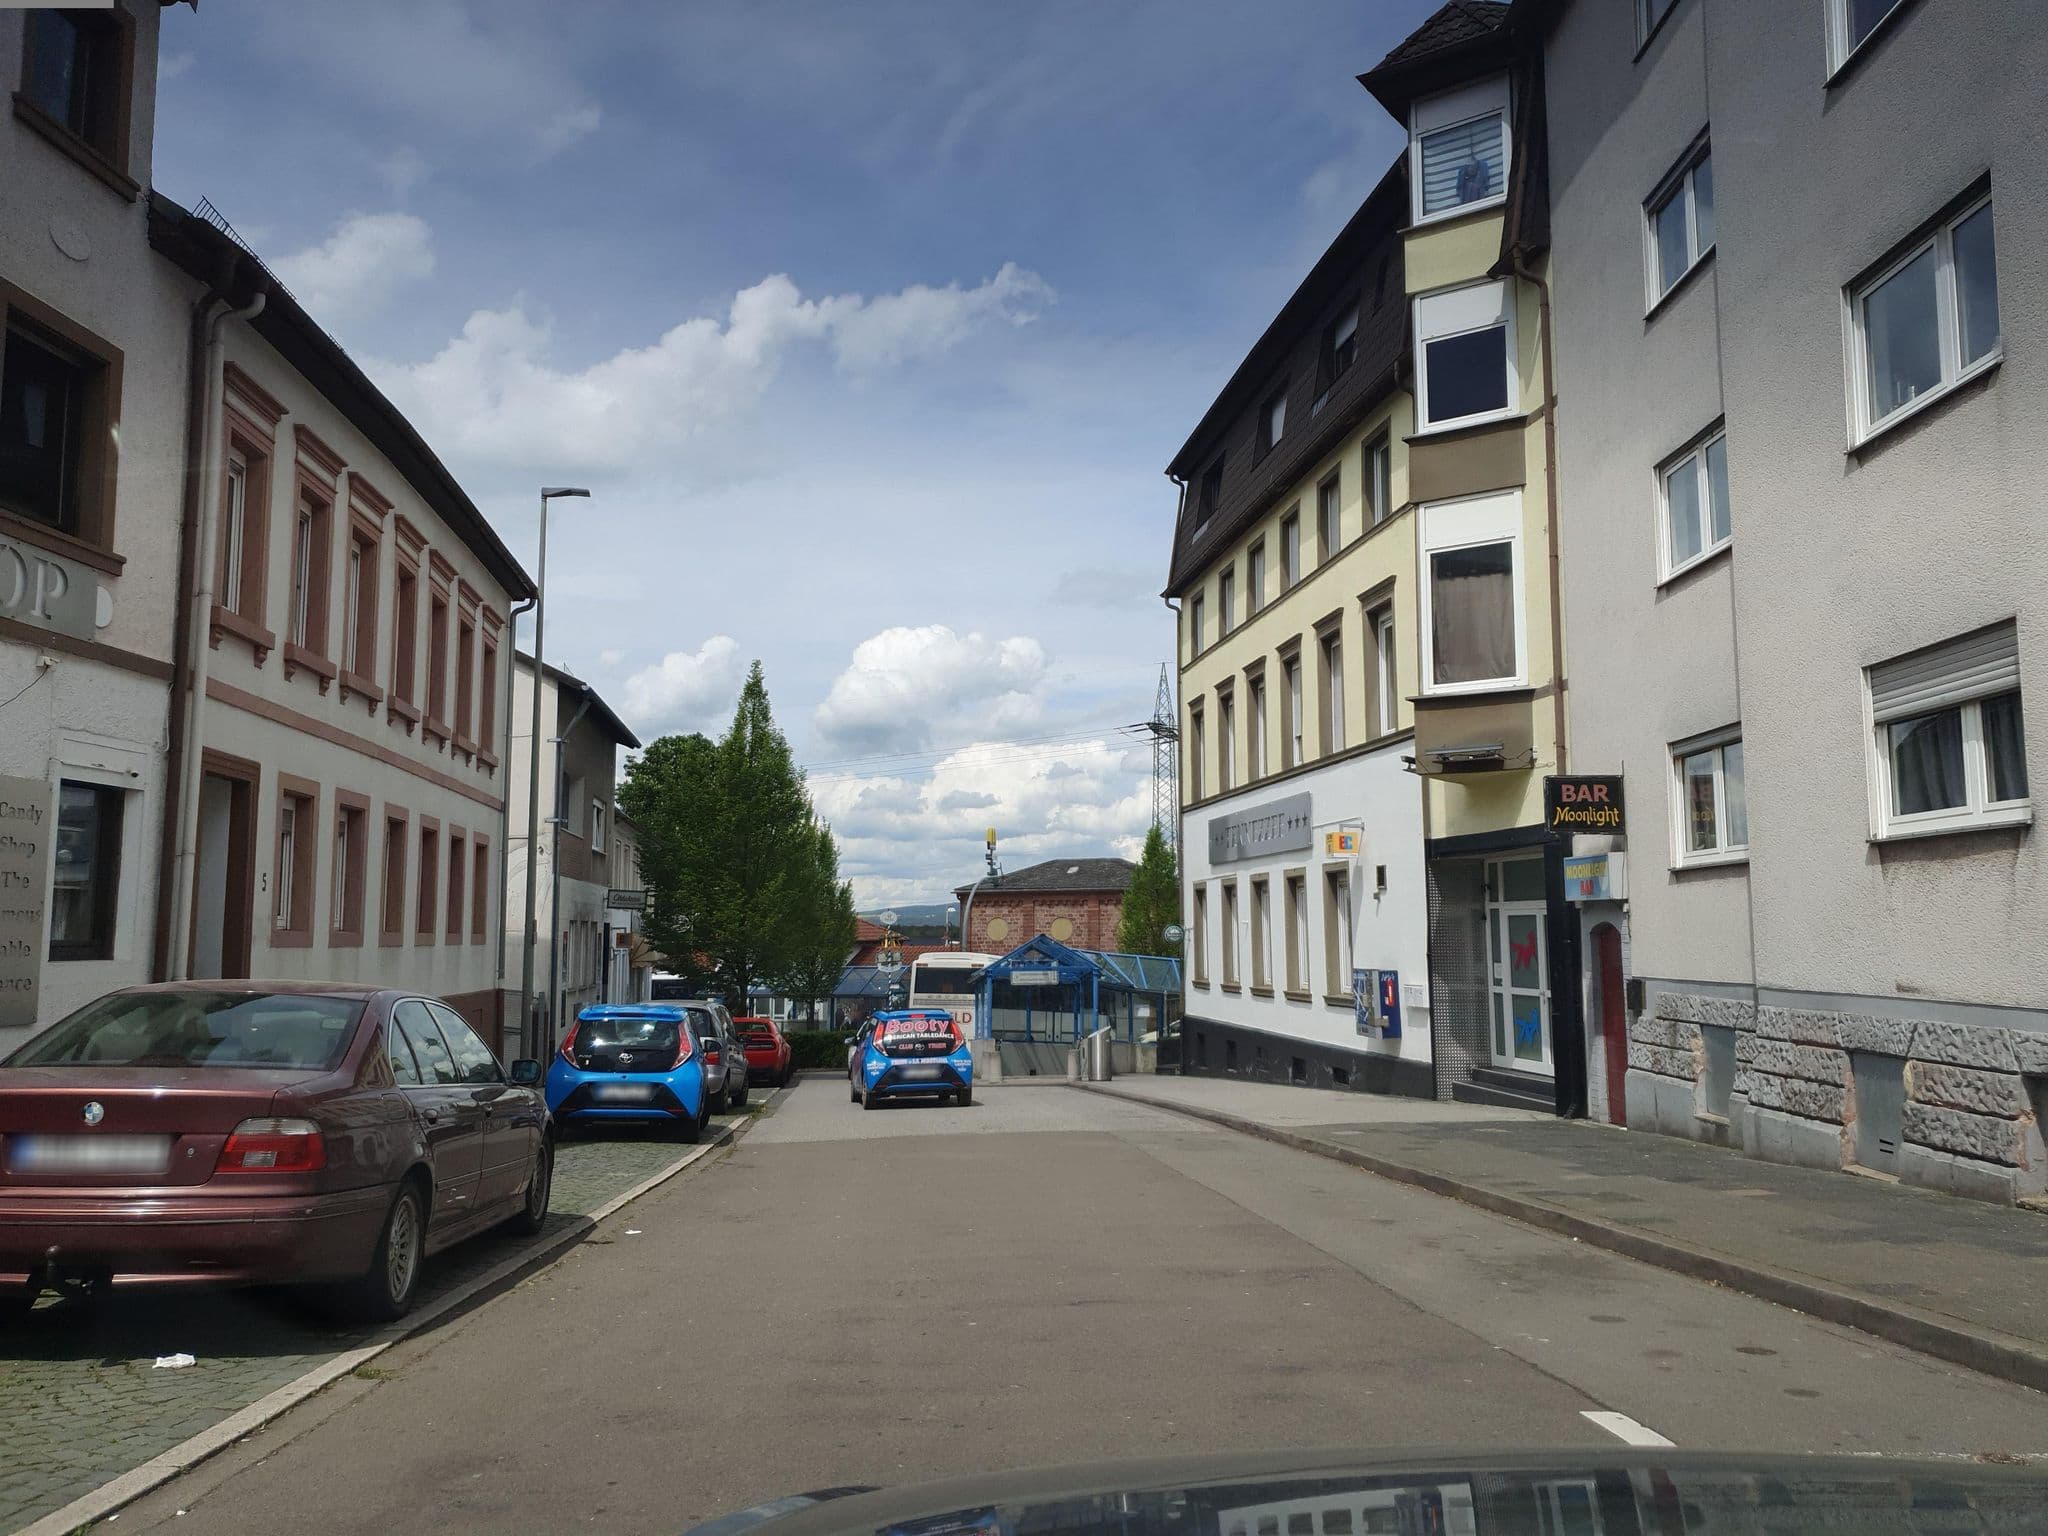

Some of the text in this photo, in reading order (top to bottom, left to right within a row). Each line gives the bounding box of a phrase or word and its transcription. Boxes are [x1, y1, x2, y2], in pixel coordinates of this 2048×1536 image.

[1561, 784, 1610, 803] BAR
[0, 801, 43, 825] Candy
[1553, 806, 1620, 827] Moonlight
[1339, 835, 1353, 850] EC
[2, 871, 30, 889] The
[954, 1012, 972, 1024] LD
[885, 1019, 949, 1034] Booty
[884, 1033, 916, 1041] ERICAN
